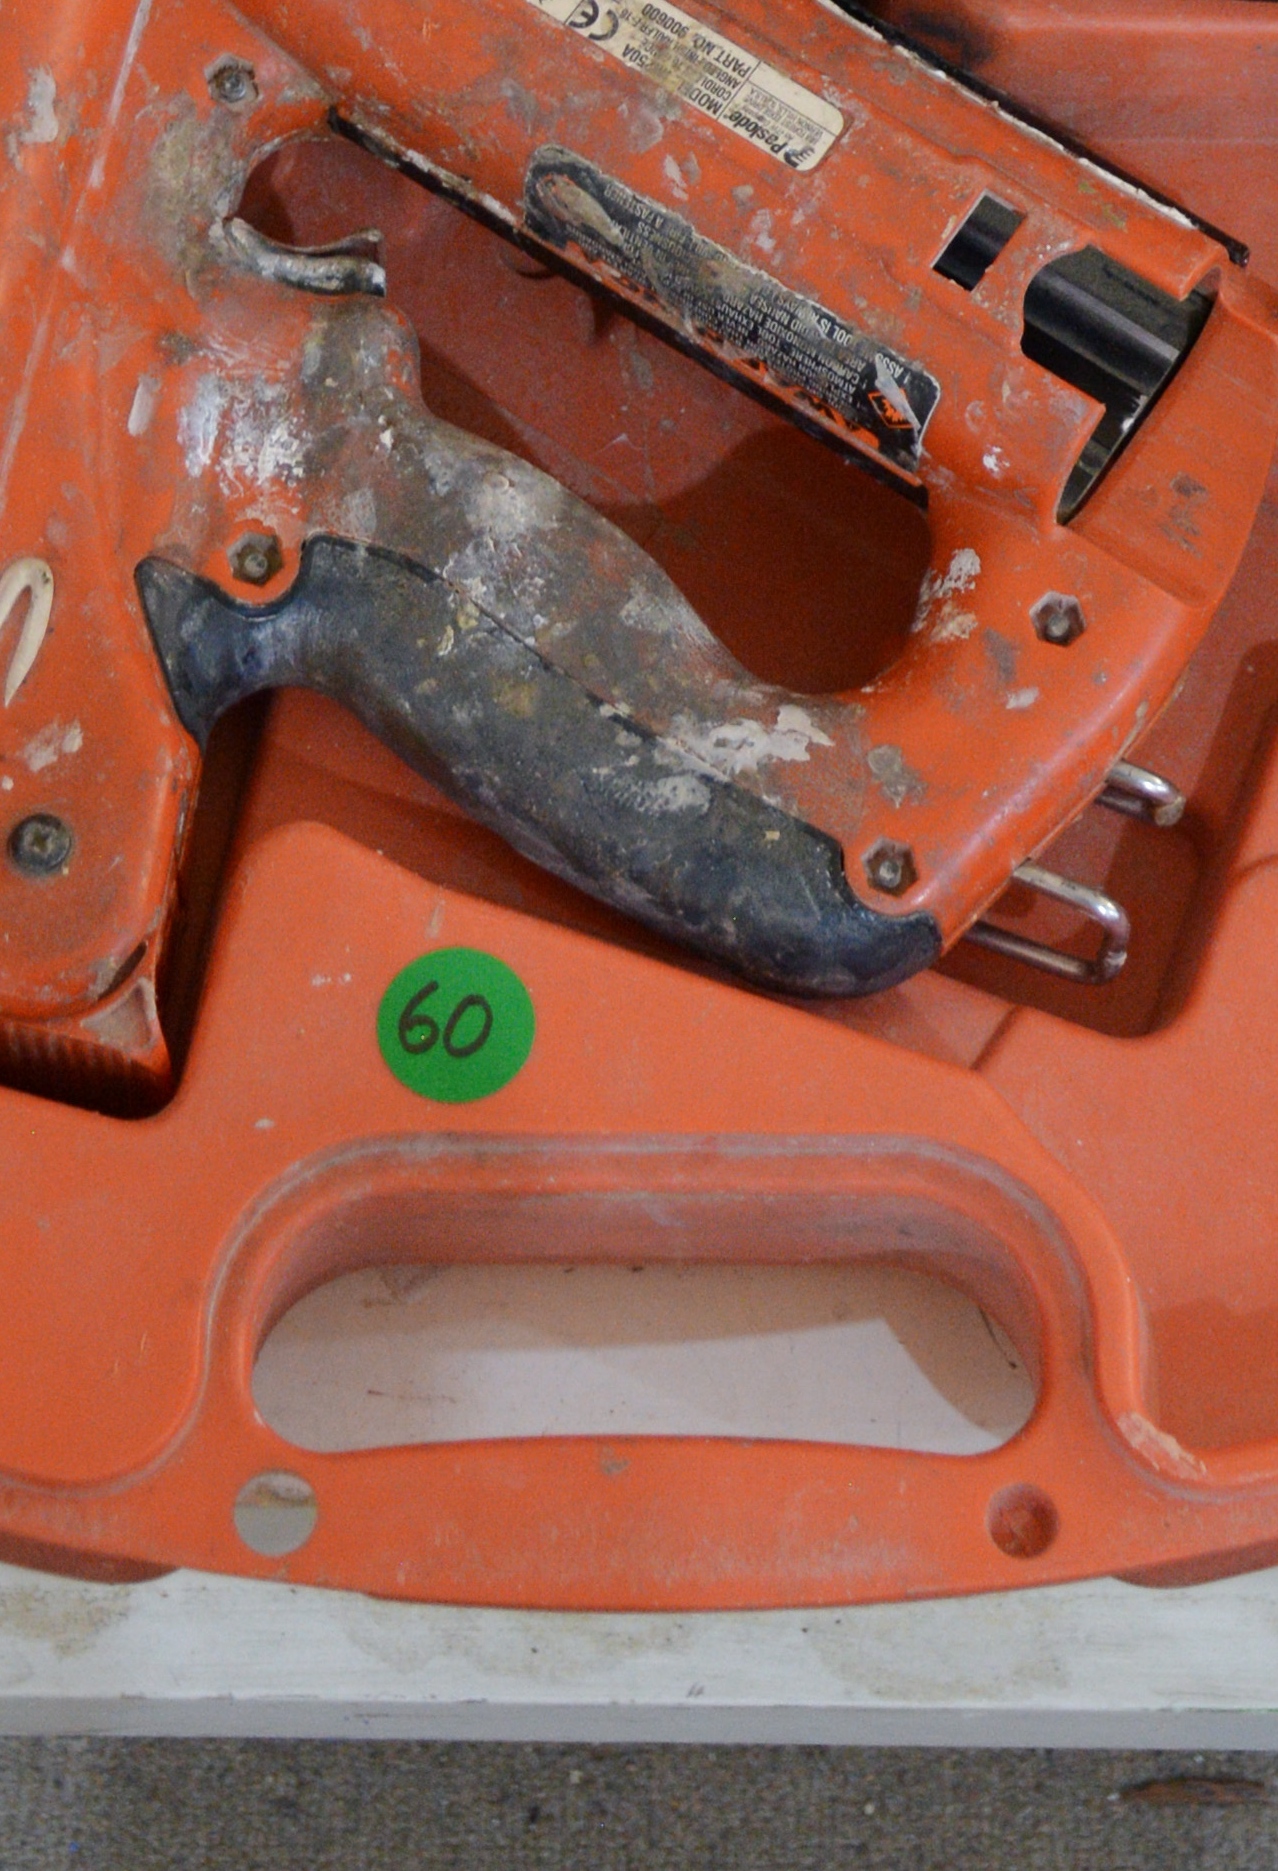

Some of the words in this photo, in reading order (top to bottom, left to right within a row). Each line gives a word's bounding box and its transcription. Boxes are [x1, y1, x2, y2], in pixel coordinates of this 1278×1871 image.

[641, 2, 689, 39] 900600
[713, 48, 750, 78] PART
[726, 109, 787, 155] Paslode
[399, 981, 493, 1058] 60
